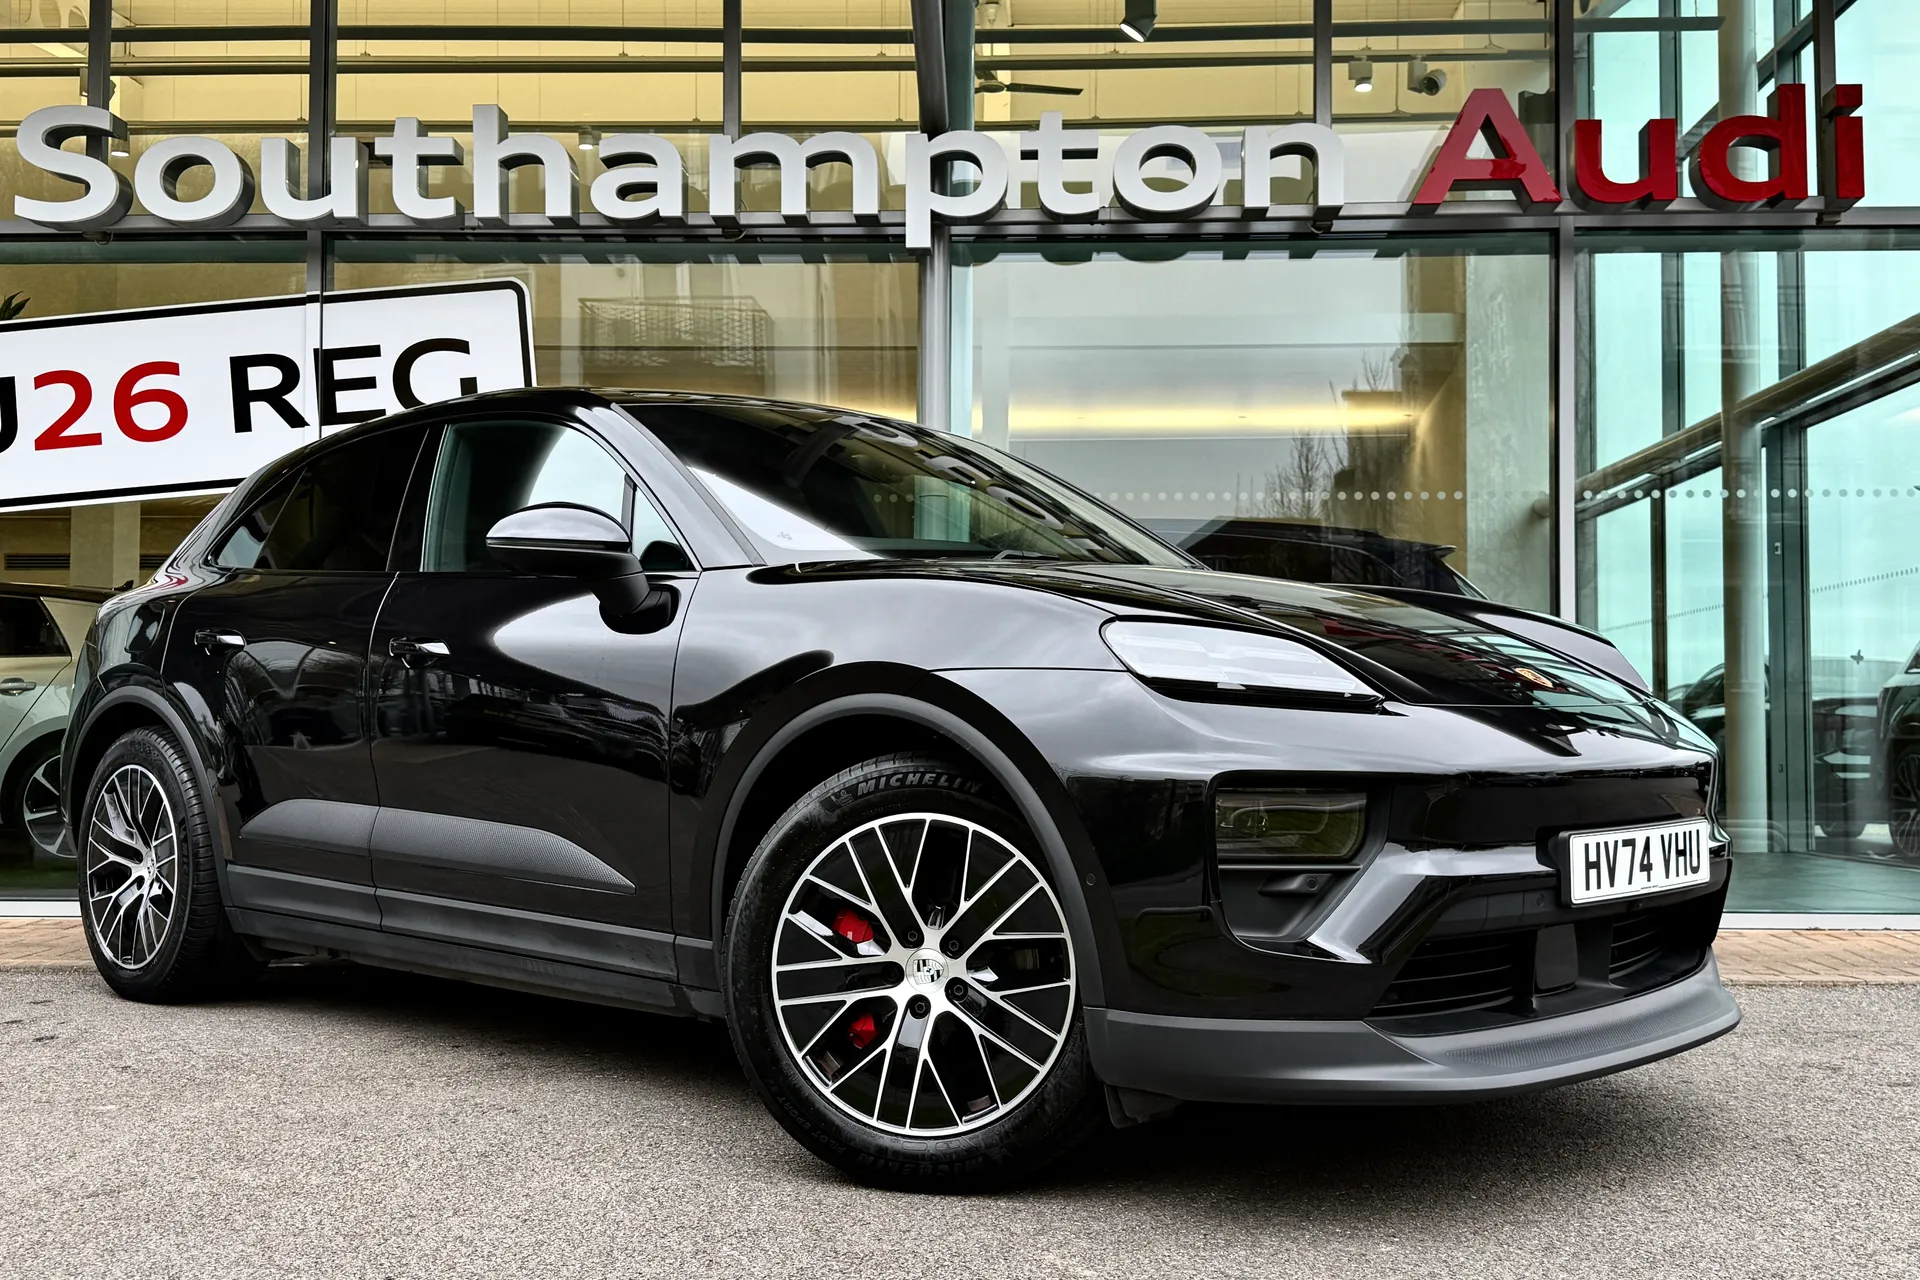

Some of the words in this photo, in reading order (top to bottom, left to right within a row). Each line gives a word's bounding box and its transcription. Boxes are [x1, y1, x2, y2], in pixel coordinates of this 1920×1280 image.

[14, 104, 1344, 249] Southampton
[1410, 84, 1866, 210] Audi
[0, 361, 188, 453] 26
[229, 338, 478, 434] REG
[856, 772, 984, 796] MICHELIN
[1584, 836, 1653, 891] HV74
[1660, 829, 1701, 880] VHU
